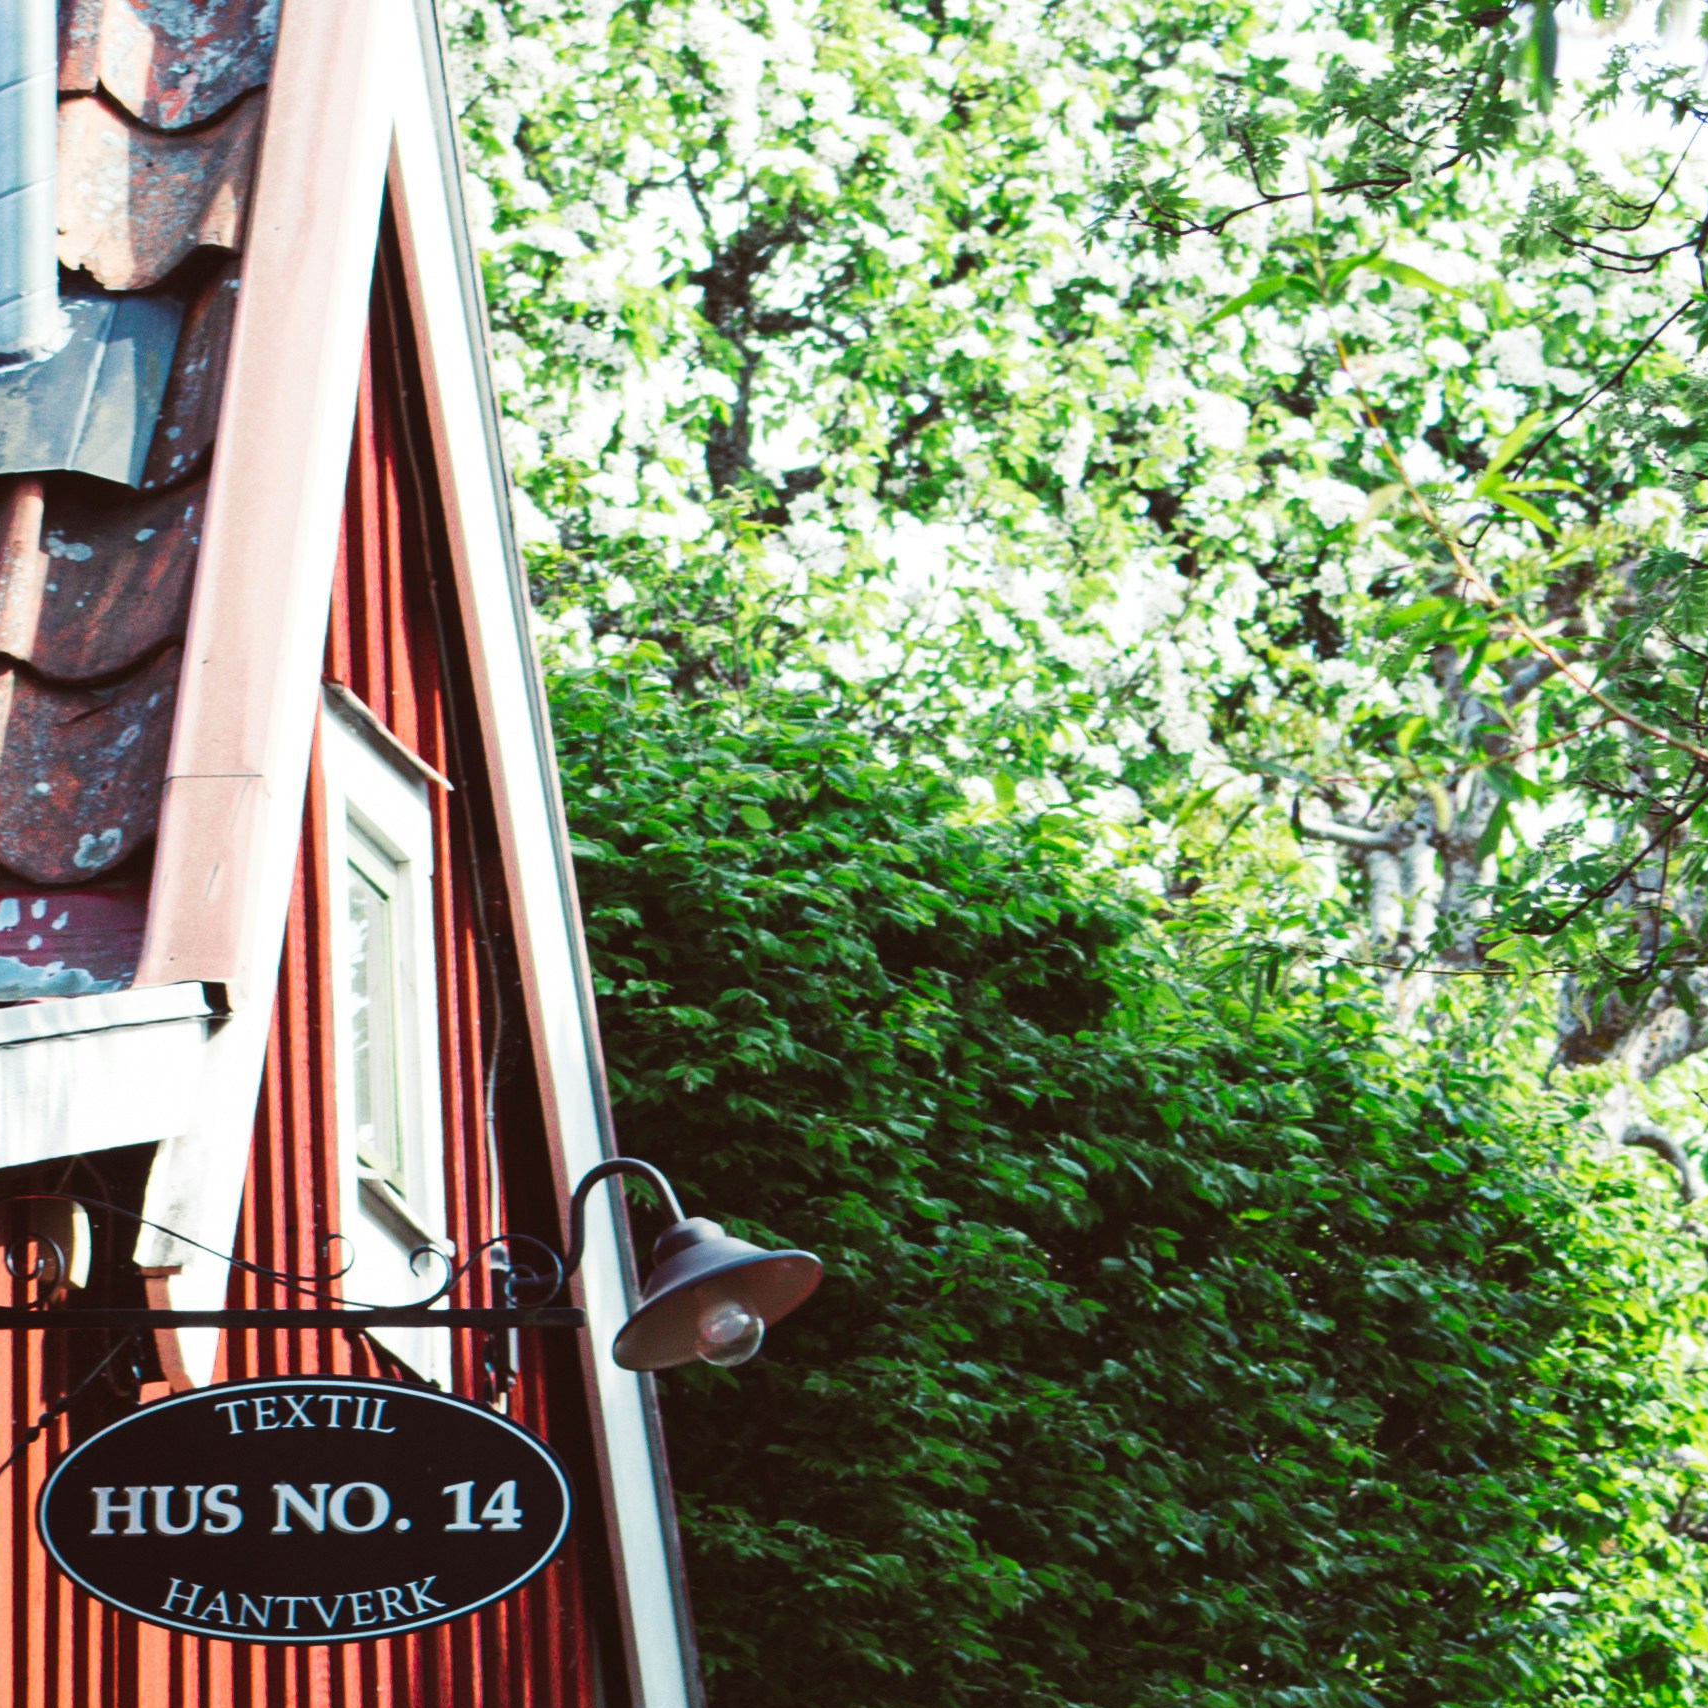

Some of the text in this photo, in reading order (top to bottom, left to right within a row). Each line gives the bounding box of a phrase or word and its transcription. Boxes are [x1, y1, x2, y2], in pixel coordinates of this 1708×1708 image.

[215, 1393, 397, 1435] TEXTIL
[90, 1480, 523, 1536] HUS NO. 14
[160, 1575, 447, 1630] HANTVERK
